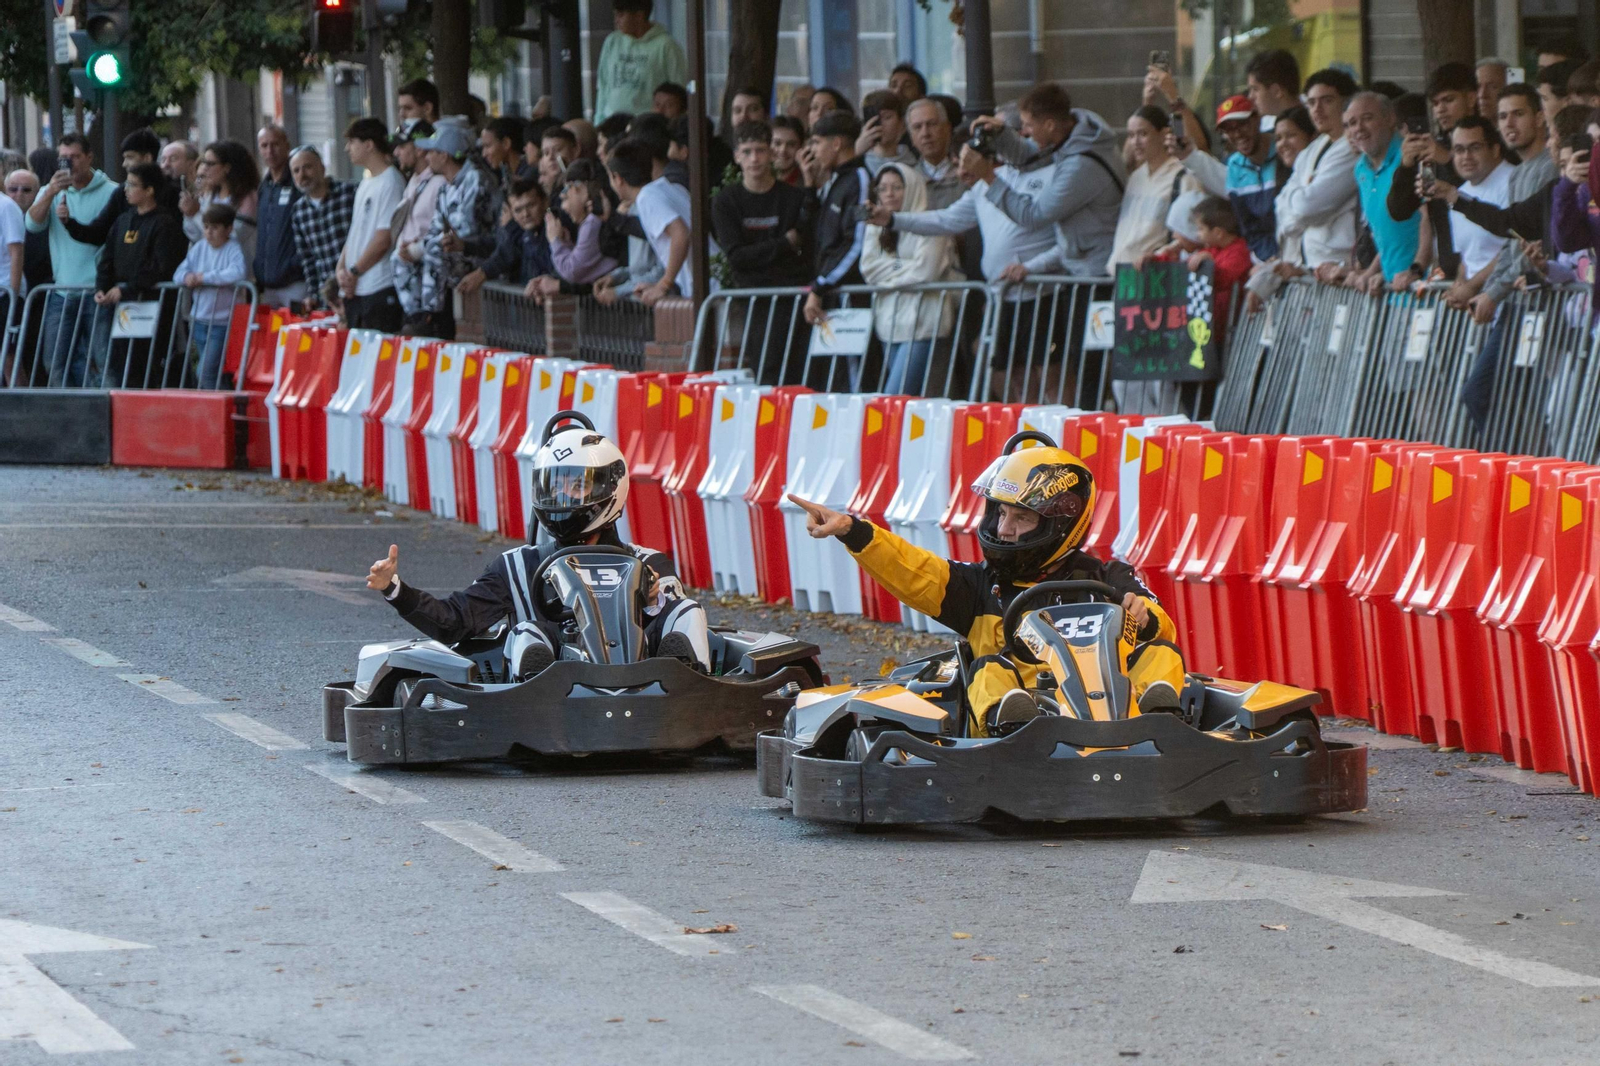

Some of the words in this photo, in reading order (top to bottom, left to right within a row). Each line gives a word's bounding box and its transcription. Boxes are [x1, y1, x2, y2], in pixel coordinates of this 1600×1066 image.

[585, 503, 603, 521] 13
[575, 568, 622, 586] 13
[1054, 614, 1104, 639] 33
